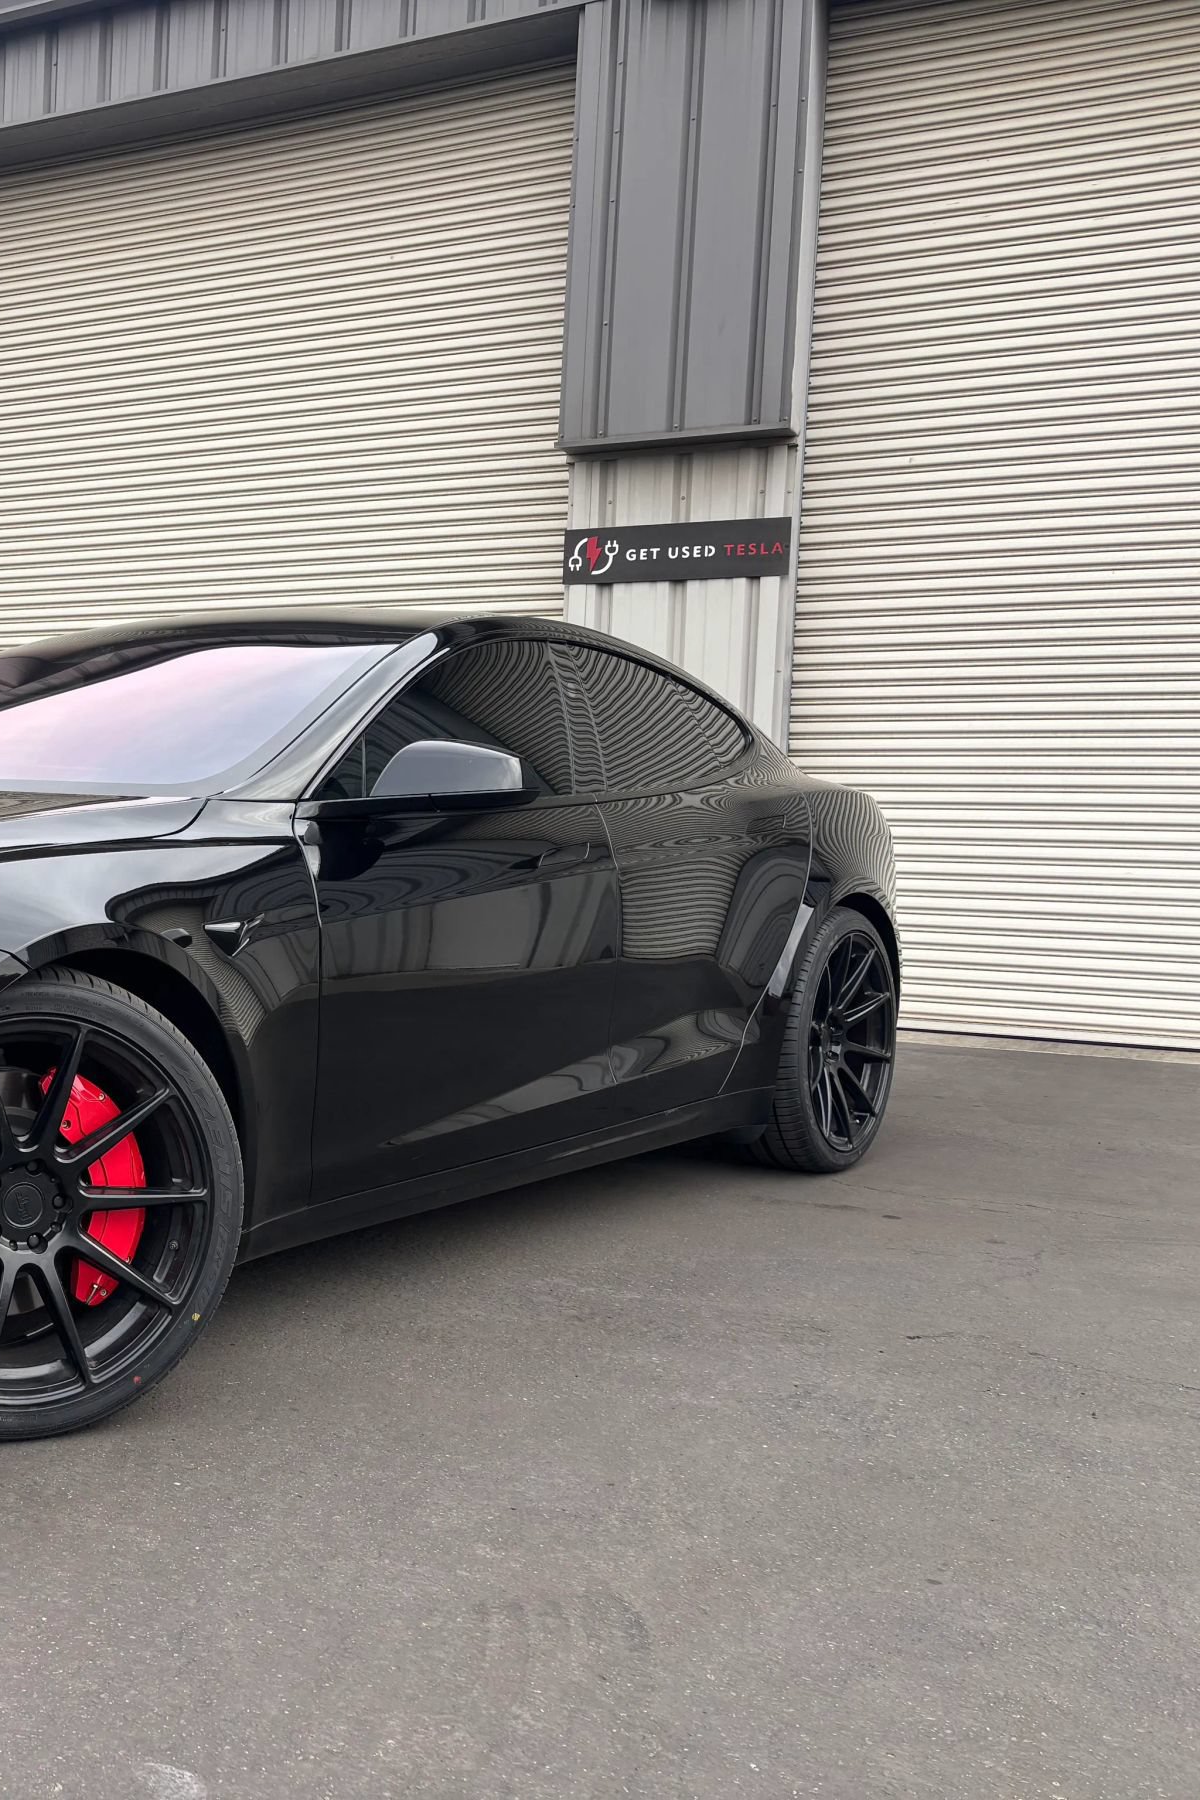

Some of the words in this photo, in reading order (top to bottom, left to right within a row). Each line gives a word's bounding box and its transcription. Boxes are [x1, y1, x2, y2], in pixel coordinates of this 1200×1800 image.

[625, 548, 661, 561] GET
[668, 545, 716, 559] USED
[724, 542, 784, 557] TESLA
